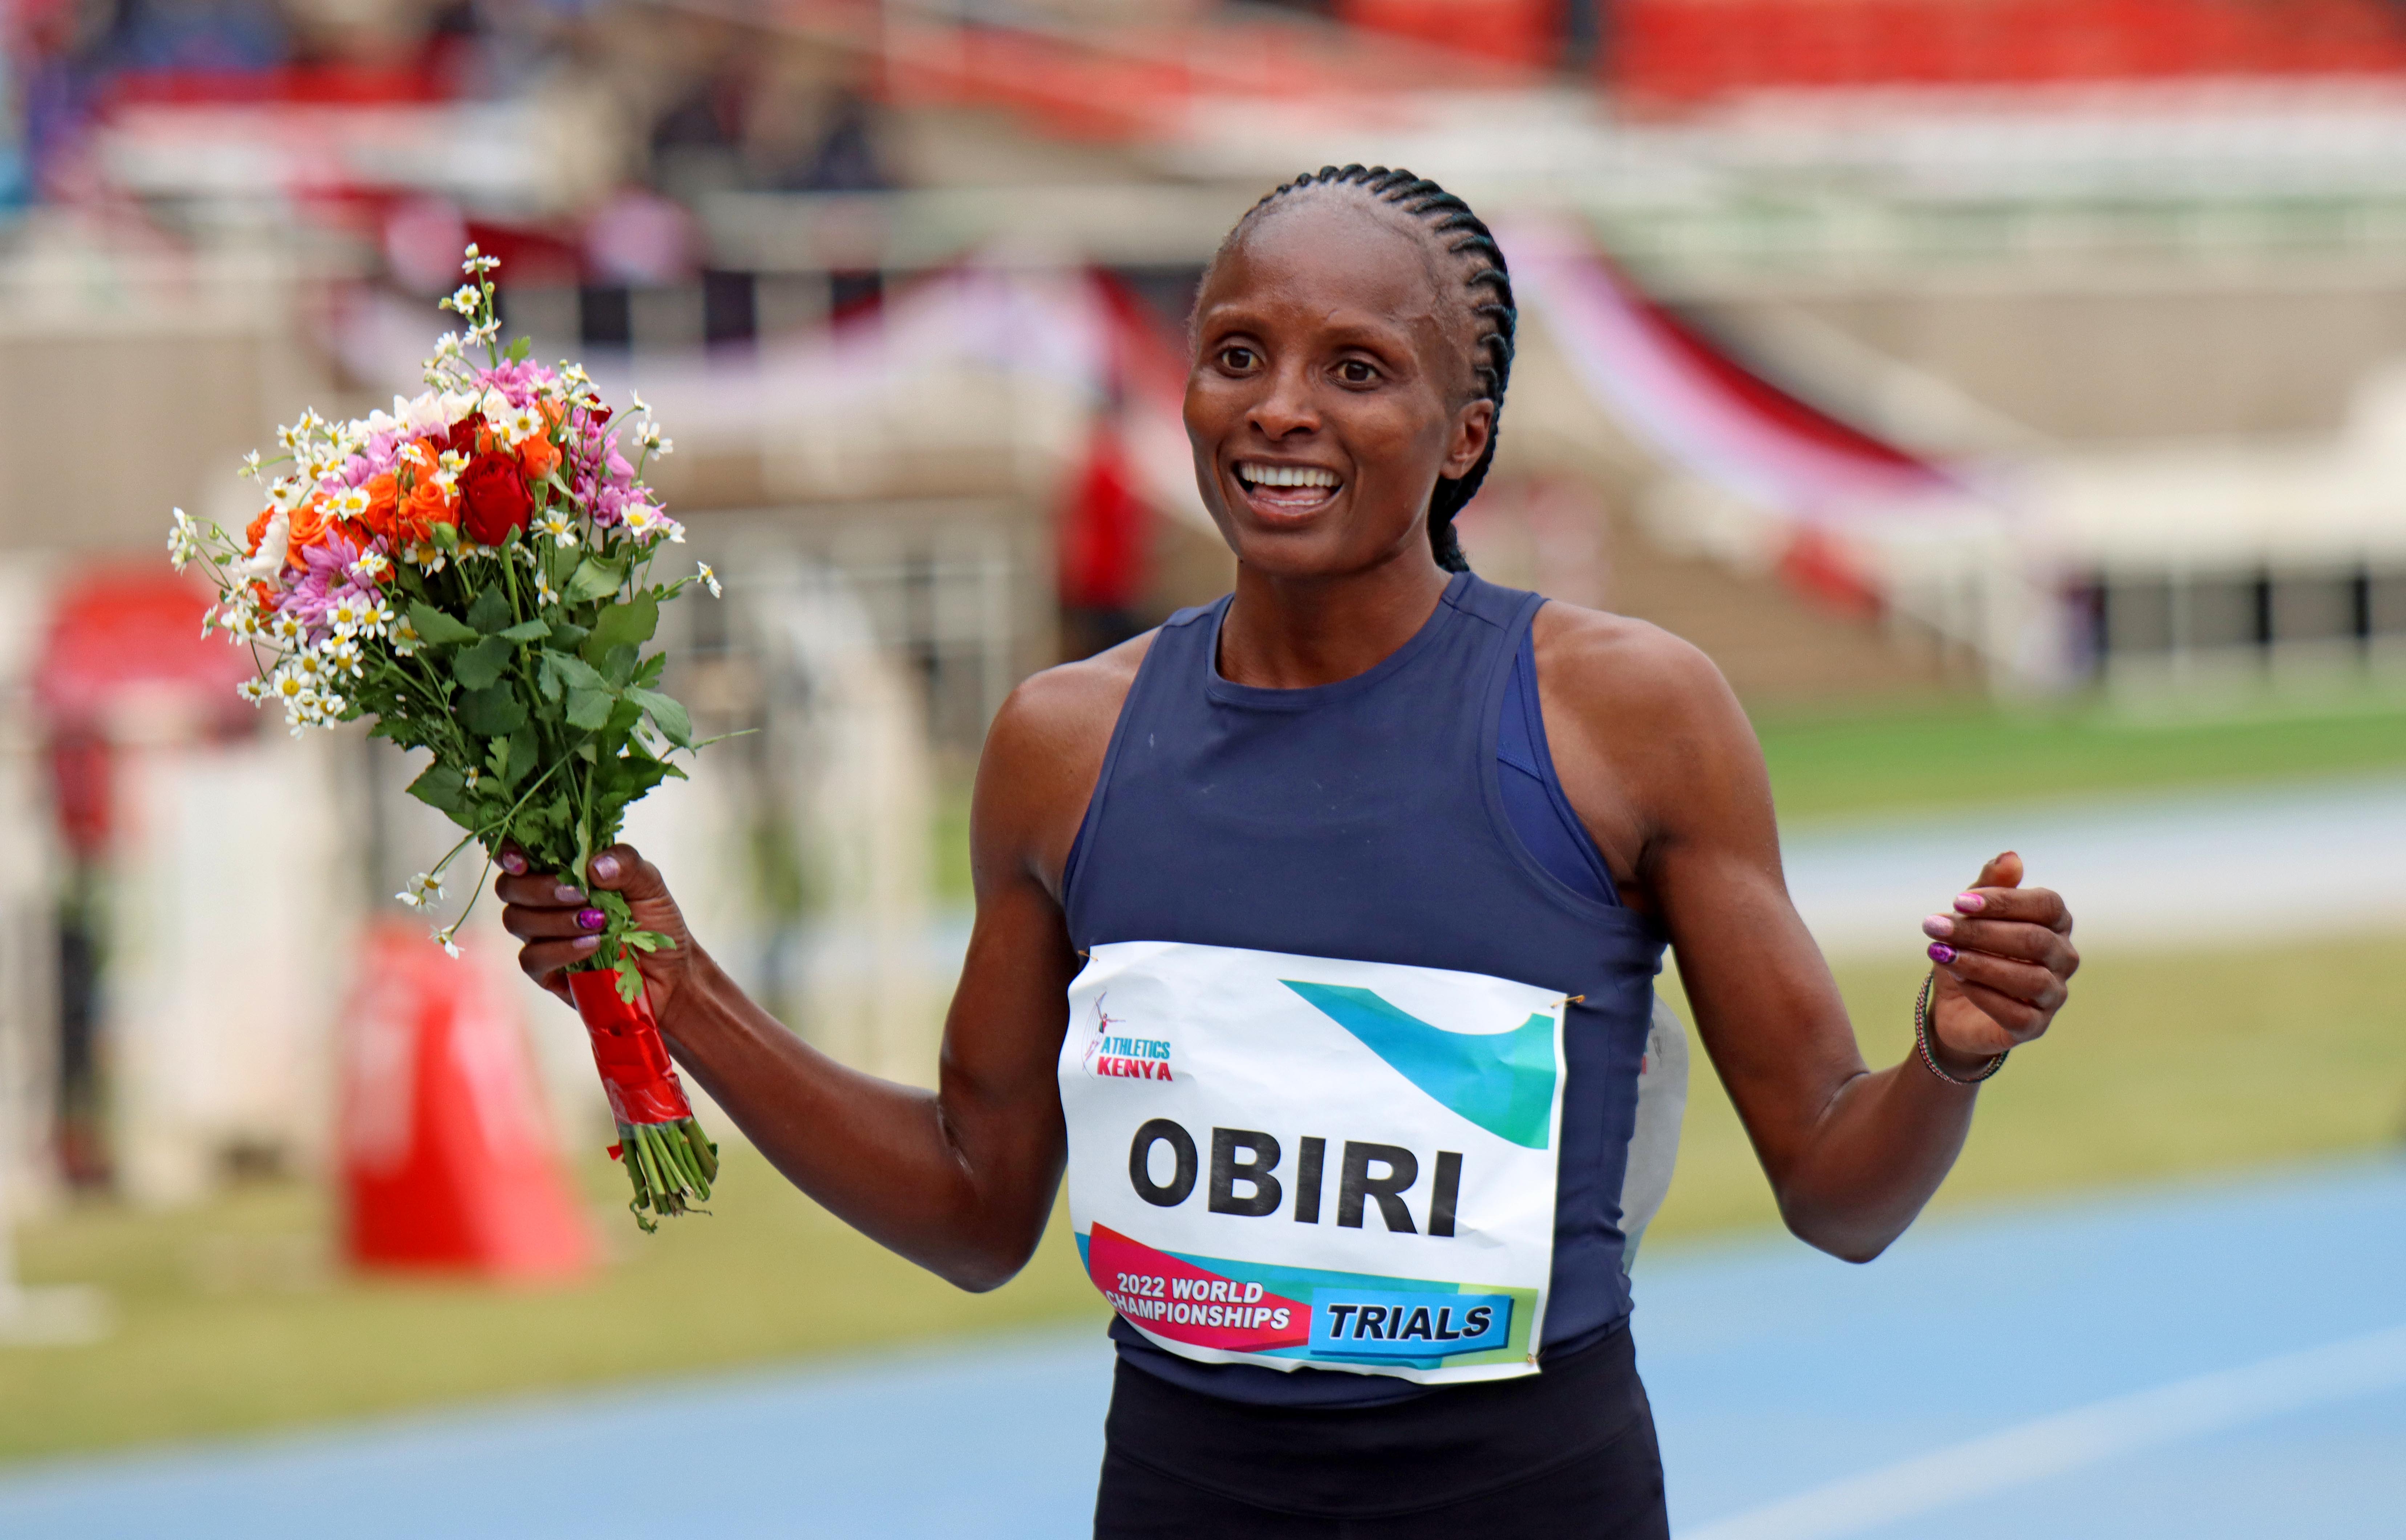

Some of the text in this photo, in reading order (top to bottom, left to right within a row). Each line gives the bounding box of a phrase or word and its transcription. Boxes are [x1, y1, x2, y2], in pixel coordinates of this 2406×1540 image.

[1099, 1036, 1171, 1059] ATHLETICS
[1097, 1056, 1173, 1082] KENYA
[1129, 1118, 1463, 1238] OBIRI
[1117, 1272, 1264, 1304] 2022 WORLD
[1105, 1290, 1291, 1330] CHAMPIONSHIPS
[1326, 1305, 1492, 1342] TRIALS
